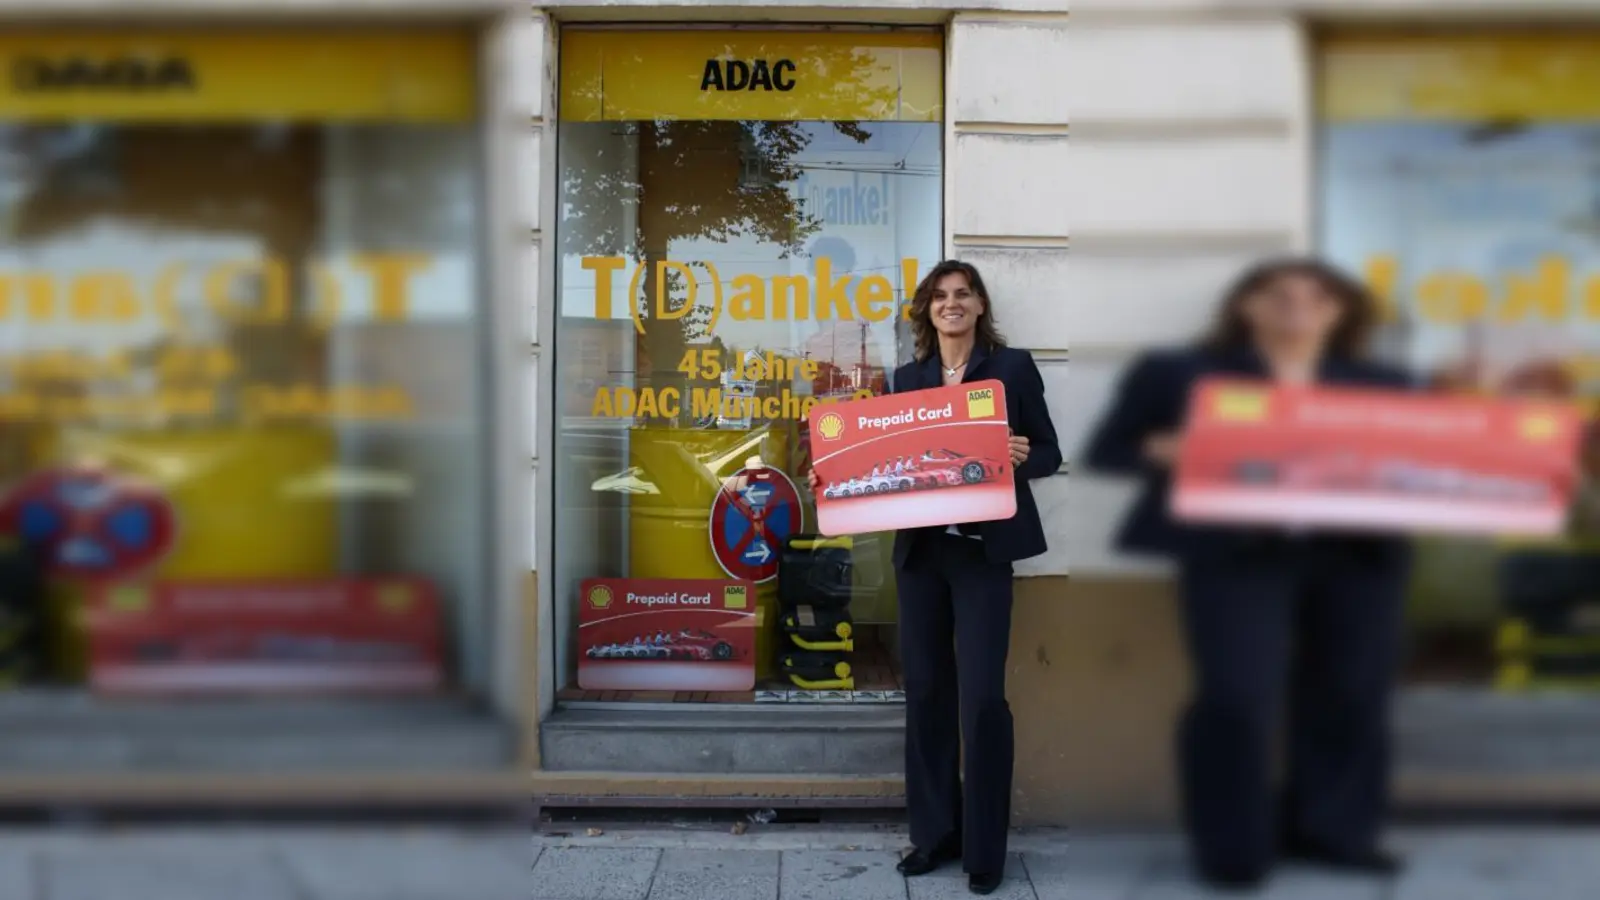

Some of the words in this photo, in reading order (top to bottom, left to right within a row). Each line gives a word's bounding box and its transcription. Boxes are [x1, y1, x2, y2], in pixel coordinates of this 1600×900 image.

[701, 59, 796, 91] ADAC
[581, 256, 918, 335] T(D)anke!
[679, 350, 721, 380] 45
[734, 351, 818, 381] Jahre
[591, 387, 680, 419] ADAC
[692, 387, 837, 420] Münche
[968, 390, 992, 401] ADAC
[858, 409, 914, 430] Prepaid
[917, 402, 952, 421] Card
[627, 593, 677, 606] Prepaid
[680, 592, 711, 604] Card
